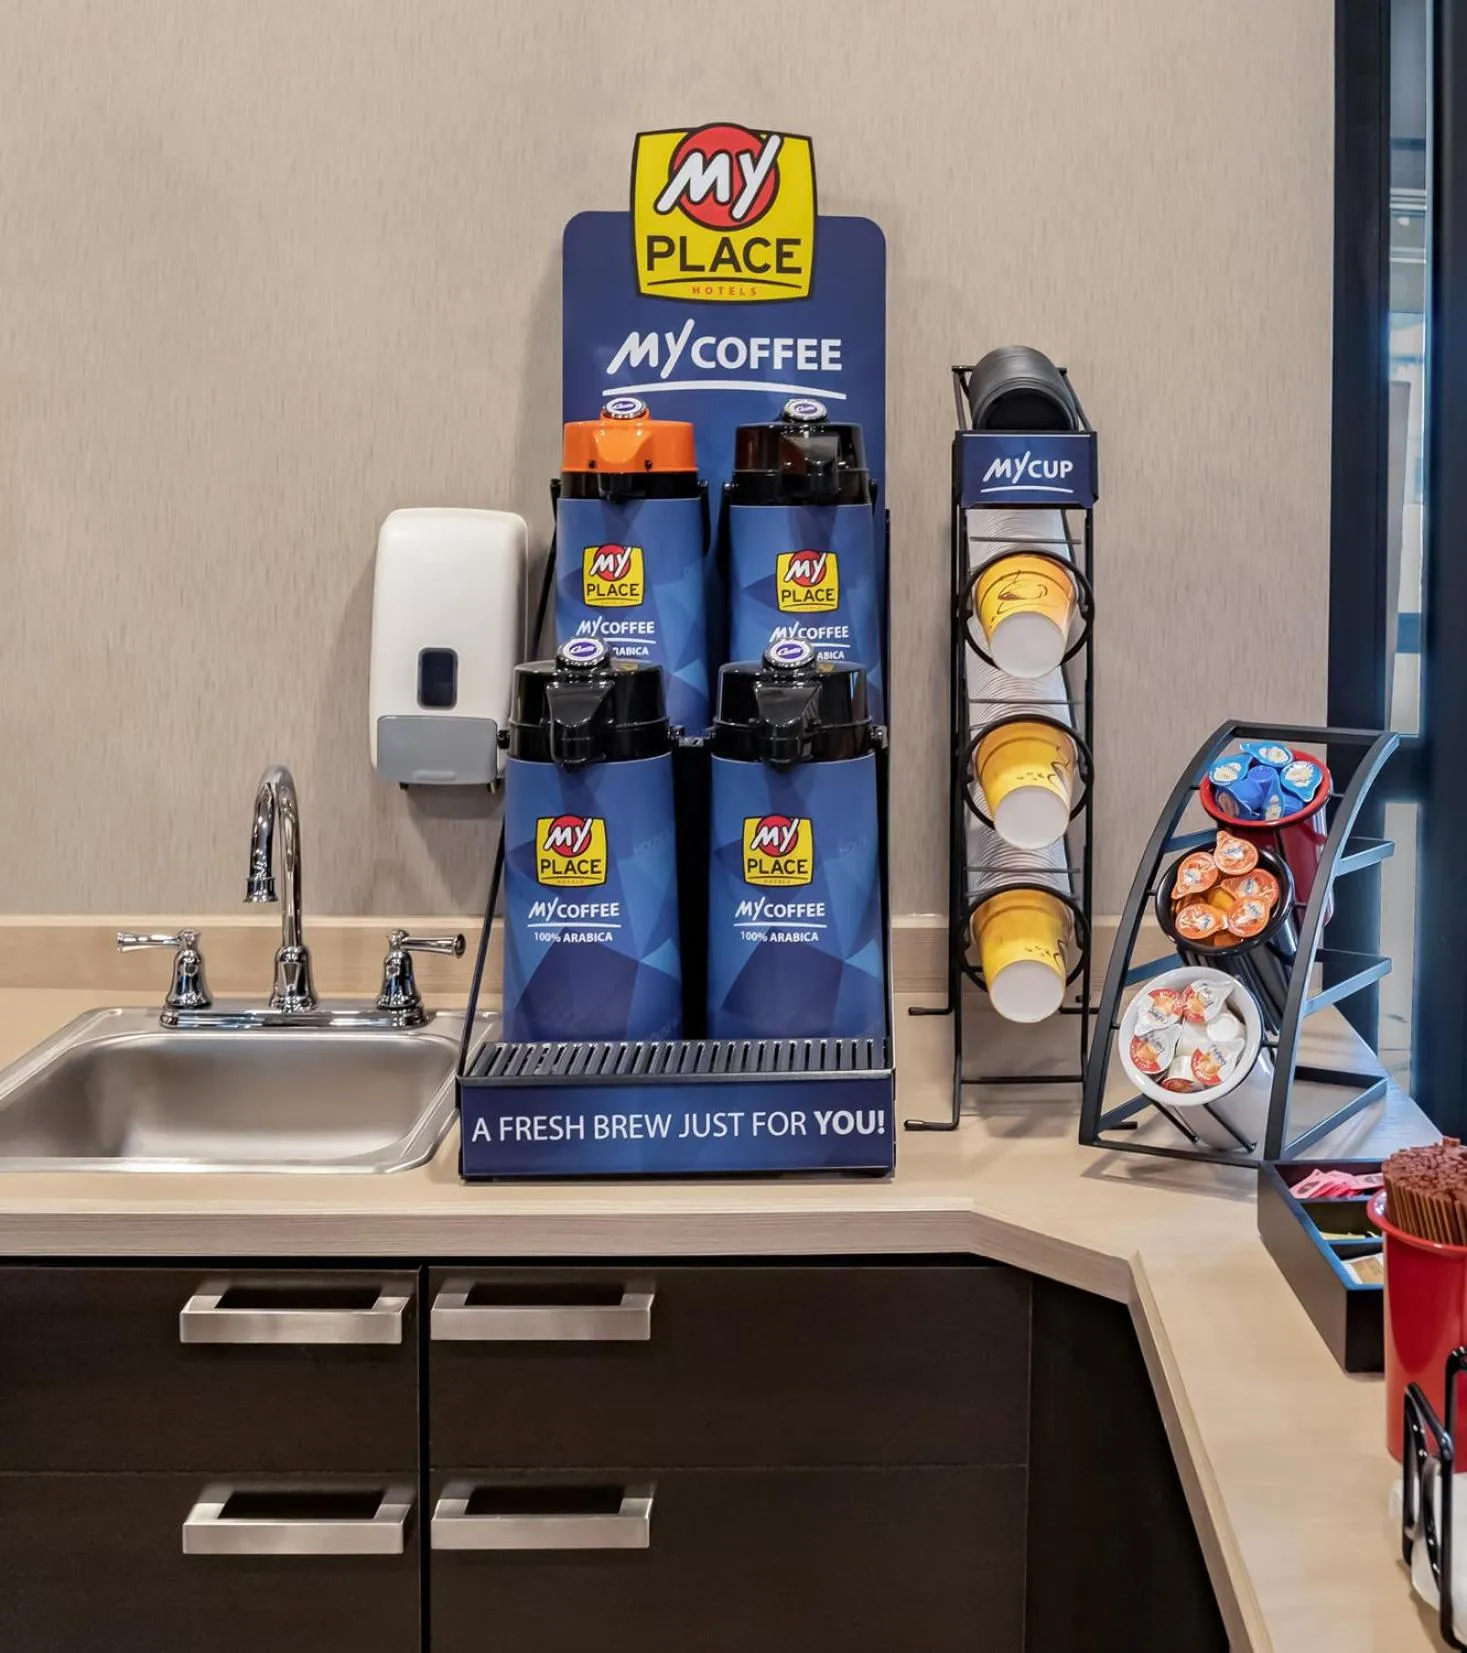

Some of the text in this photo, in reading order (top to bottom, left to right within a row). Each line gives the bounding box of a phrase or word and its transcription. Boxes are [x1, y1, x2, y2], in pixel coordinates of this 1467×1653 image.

[646, 235, 802, 274] PLACE
[692, 286, 757, 296] HOTELS
[586, 583, 640, 597] PLACE
[781, 588, 835, 603] PLACE
[541, 859, 602, 875] PLACE
[747, 859, 808, 875] PLACE
[534, 931, 614, 943] 100% ARABICA
[741, 931, 819, 943] 100% ARABICA
[471, 1110, 886, 1142] A FRESH BREW JUST FOR YOU!
